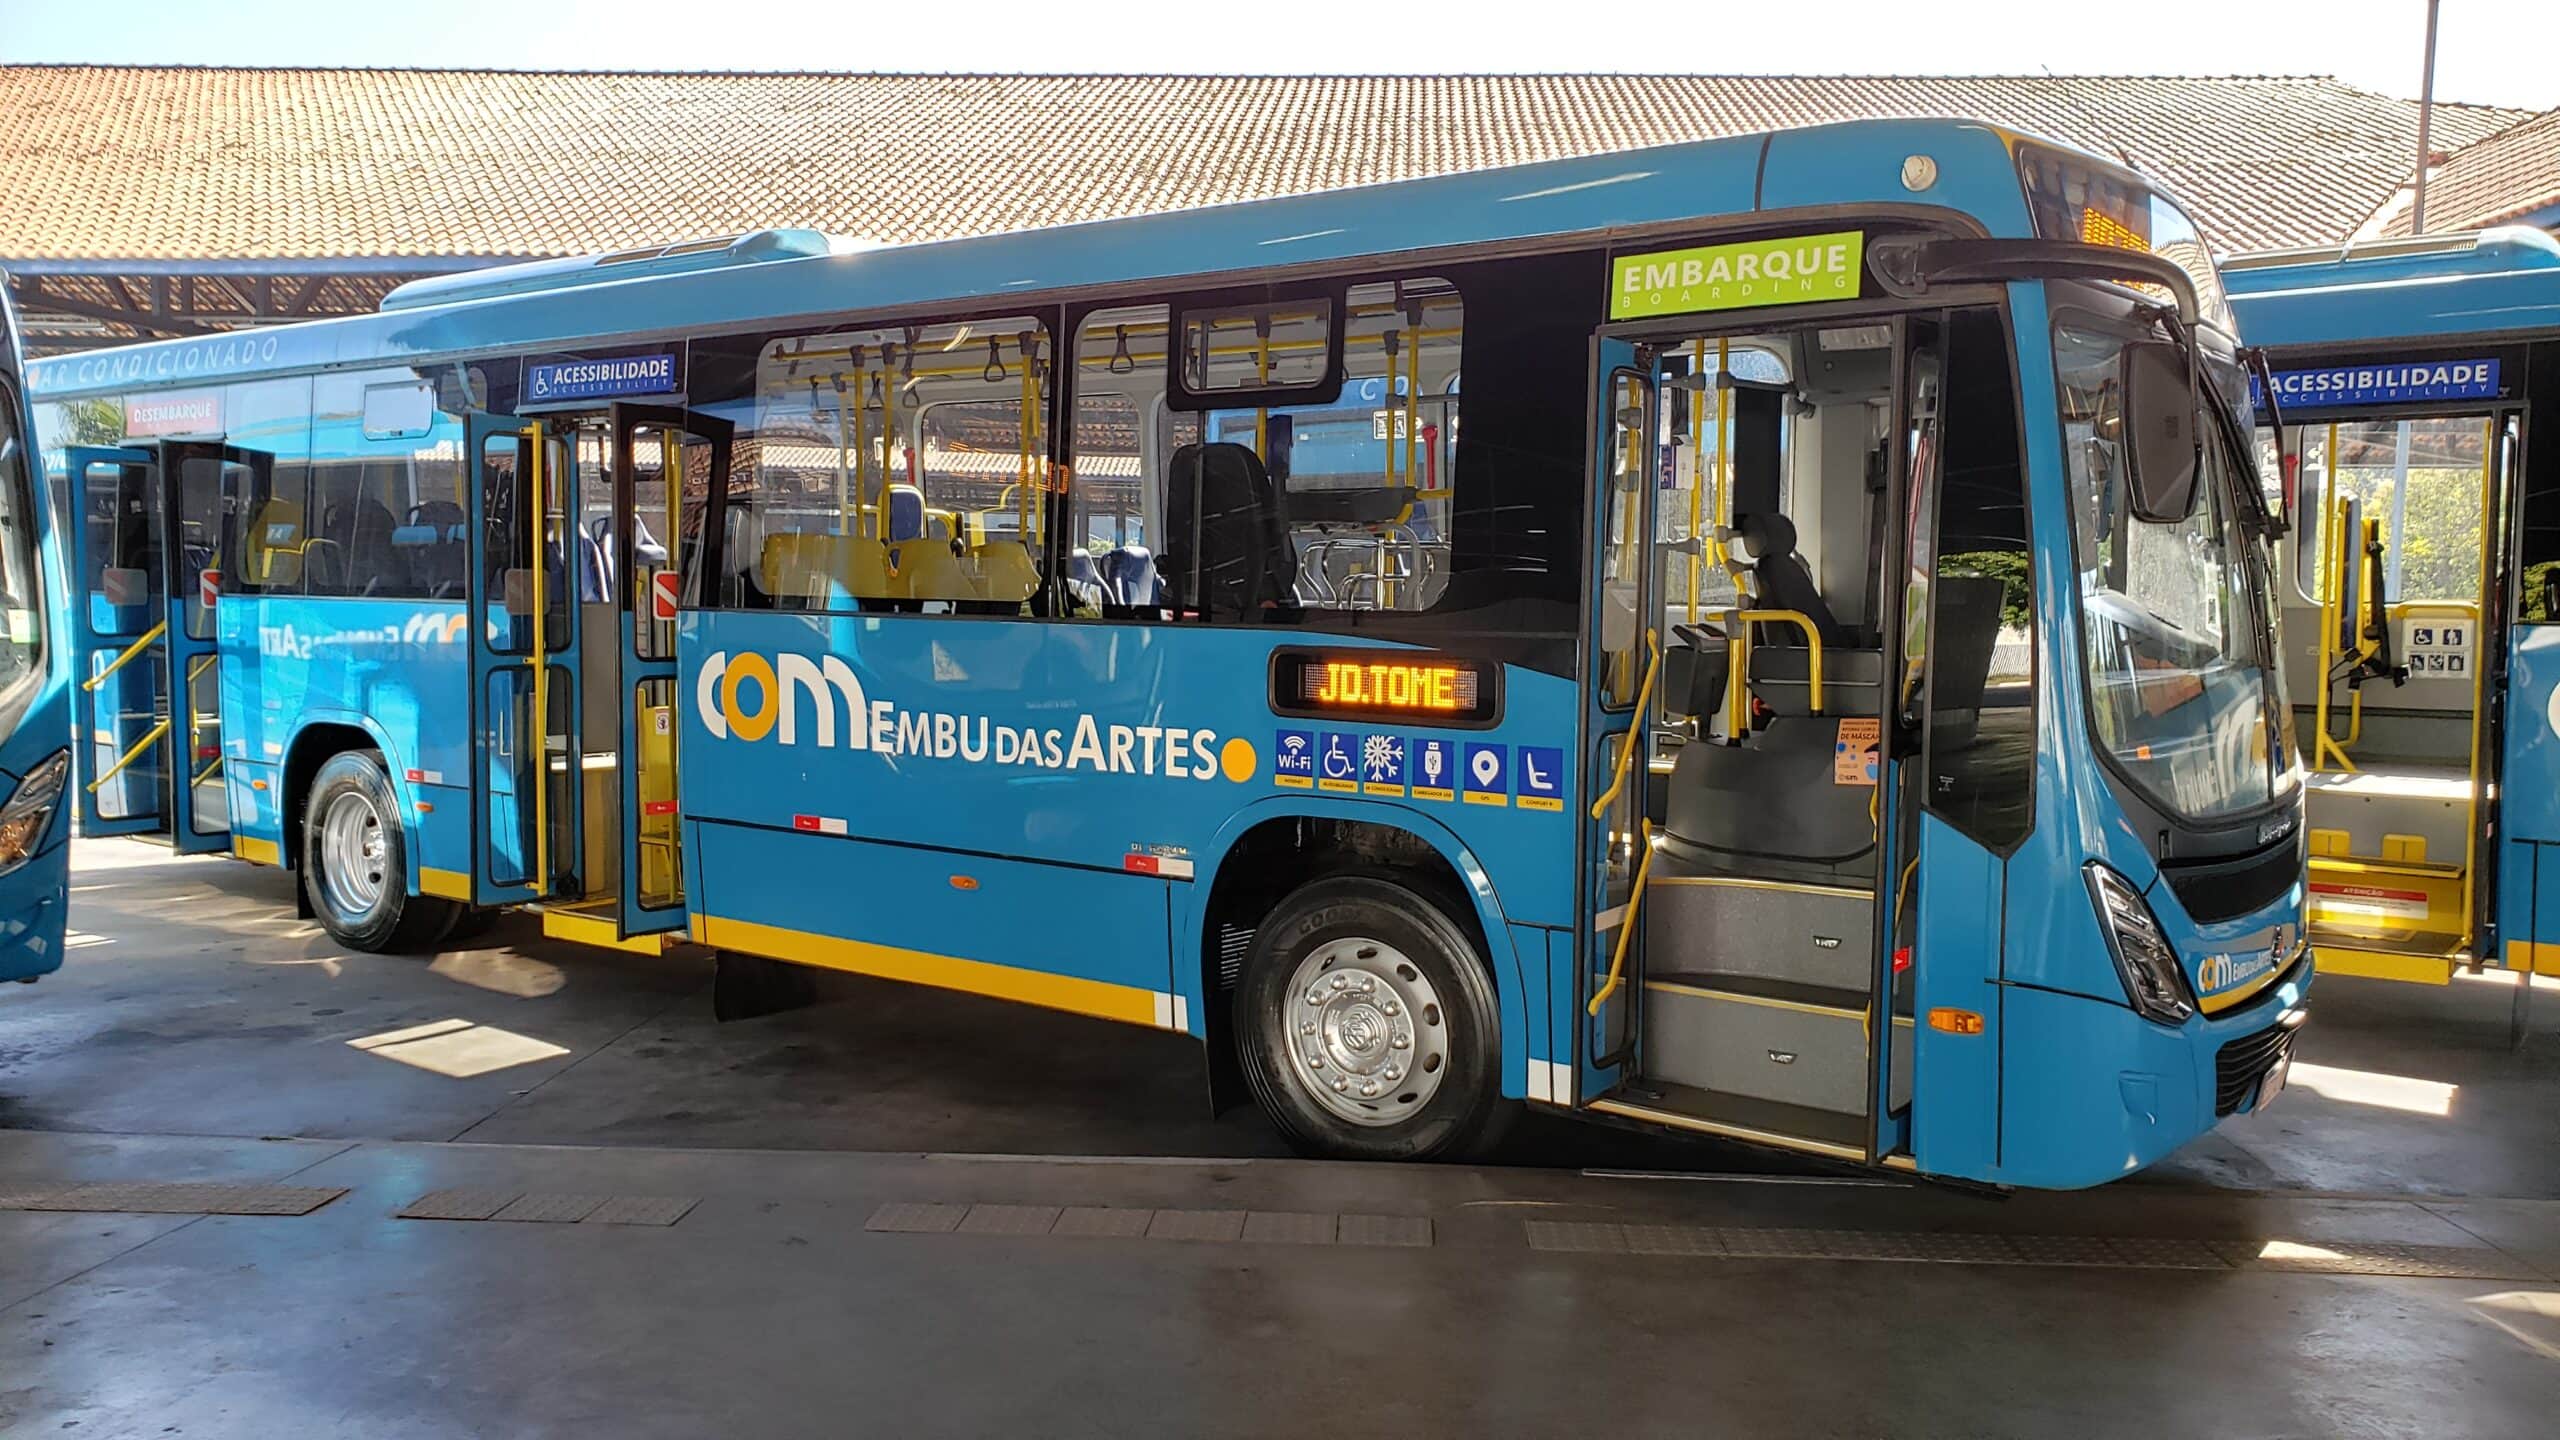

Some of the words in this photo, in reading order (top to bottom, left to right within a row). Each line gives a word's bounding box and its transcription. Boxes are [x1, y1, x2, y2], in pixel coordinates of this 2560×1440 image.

[1624, 244, 1848, 294] EMBARQUE
[1622, 275, 1846, 309] BOARDING
[42, 363, 68, 387] AR
[78, 335, 278, 383] CONDICIONADO
[553, 359, 669, 385] ACESSIBILIDADE
[2269, 364, 2489, 393] ACESSIBILIDADE
[2261, 385, 2488, 404] CCESSIBILITY
[133, 402, 212, 424] DESEMBARQUE
[1319, 663, 1456, 708] JD.TOME
[870, 700, 988, 763] EMBU
[995, 725, 1062, 769] DAS
[1067, 714, 1218, 781] ARTES
[1278, 753, 1312, 771] Wi-Fi
